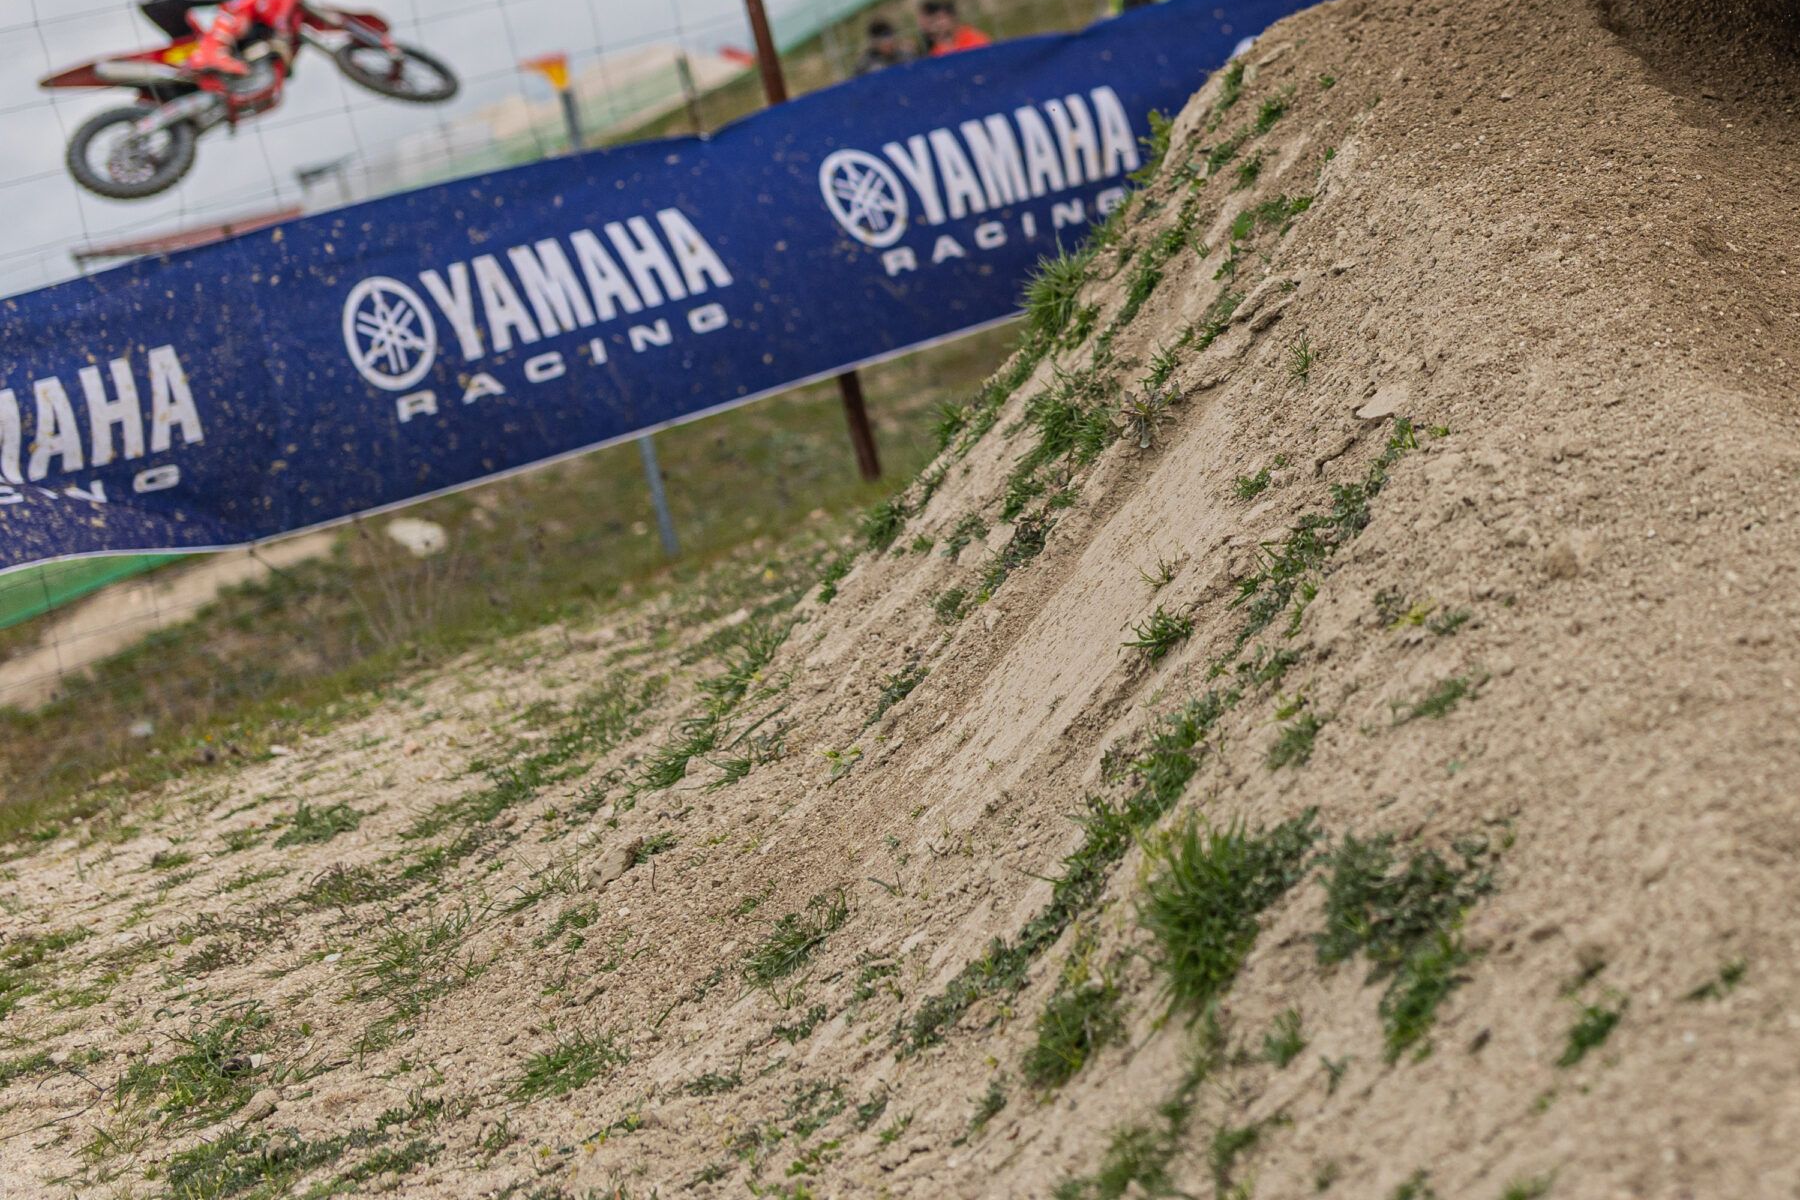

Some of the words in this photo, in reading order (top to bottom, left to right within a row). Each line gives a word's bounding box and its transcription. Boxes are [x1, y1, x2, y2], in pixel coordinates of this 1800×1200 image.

[882, 85, 1141, 226] YAMAHA
[418, 207, 733, 362] YAMAHA
[881, 186, 1130, 277] RACING
[396, 302, 730, 424] RACING
